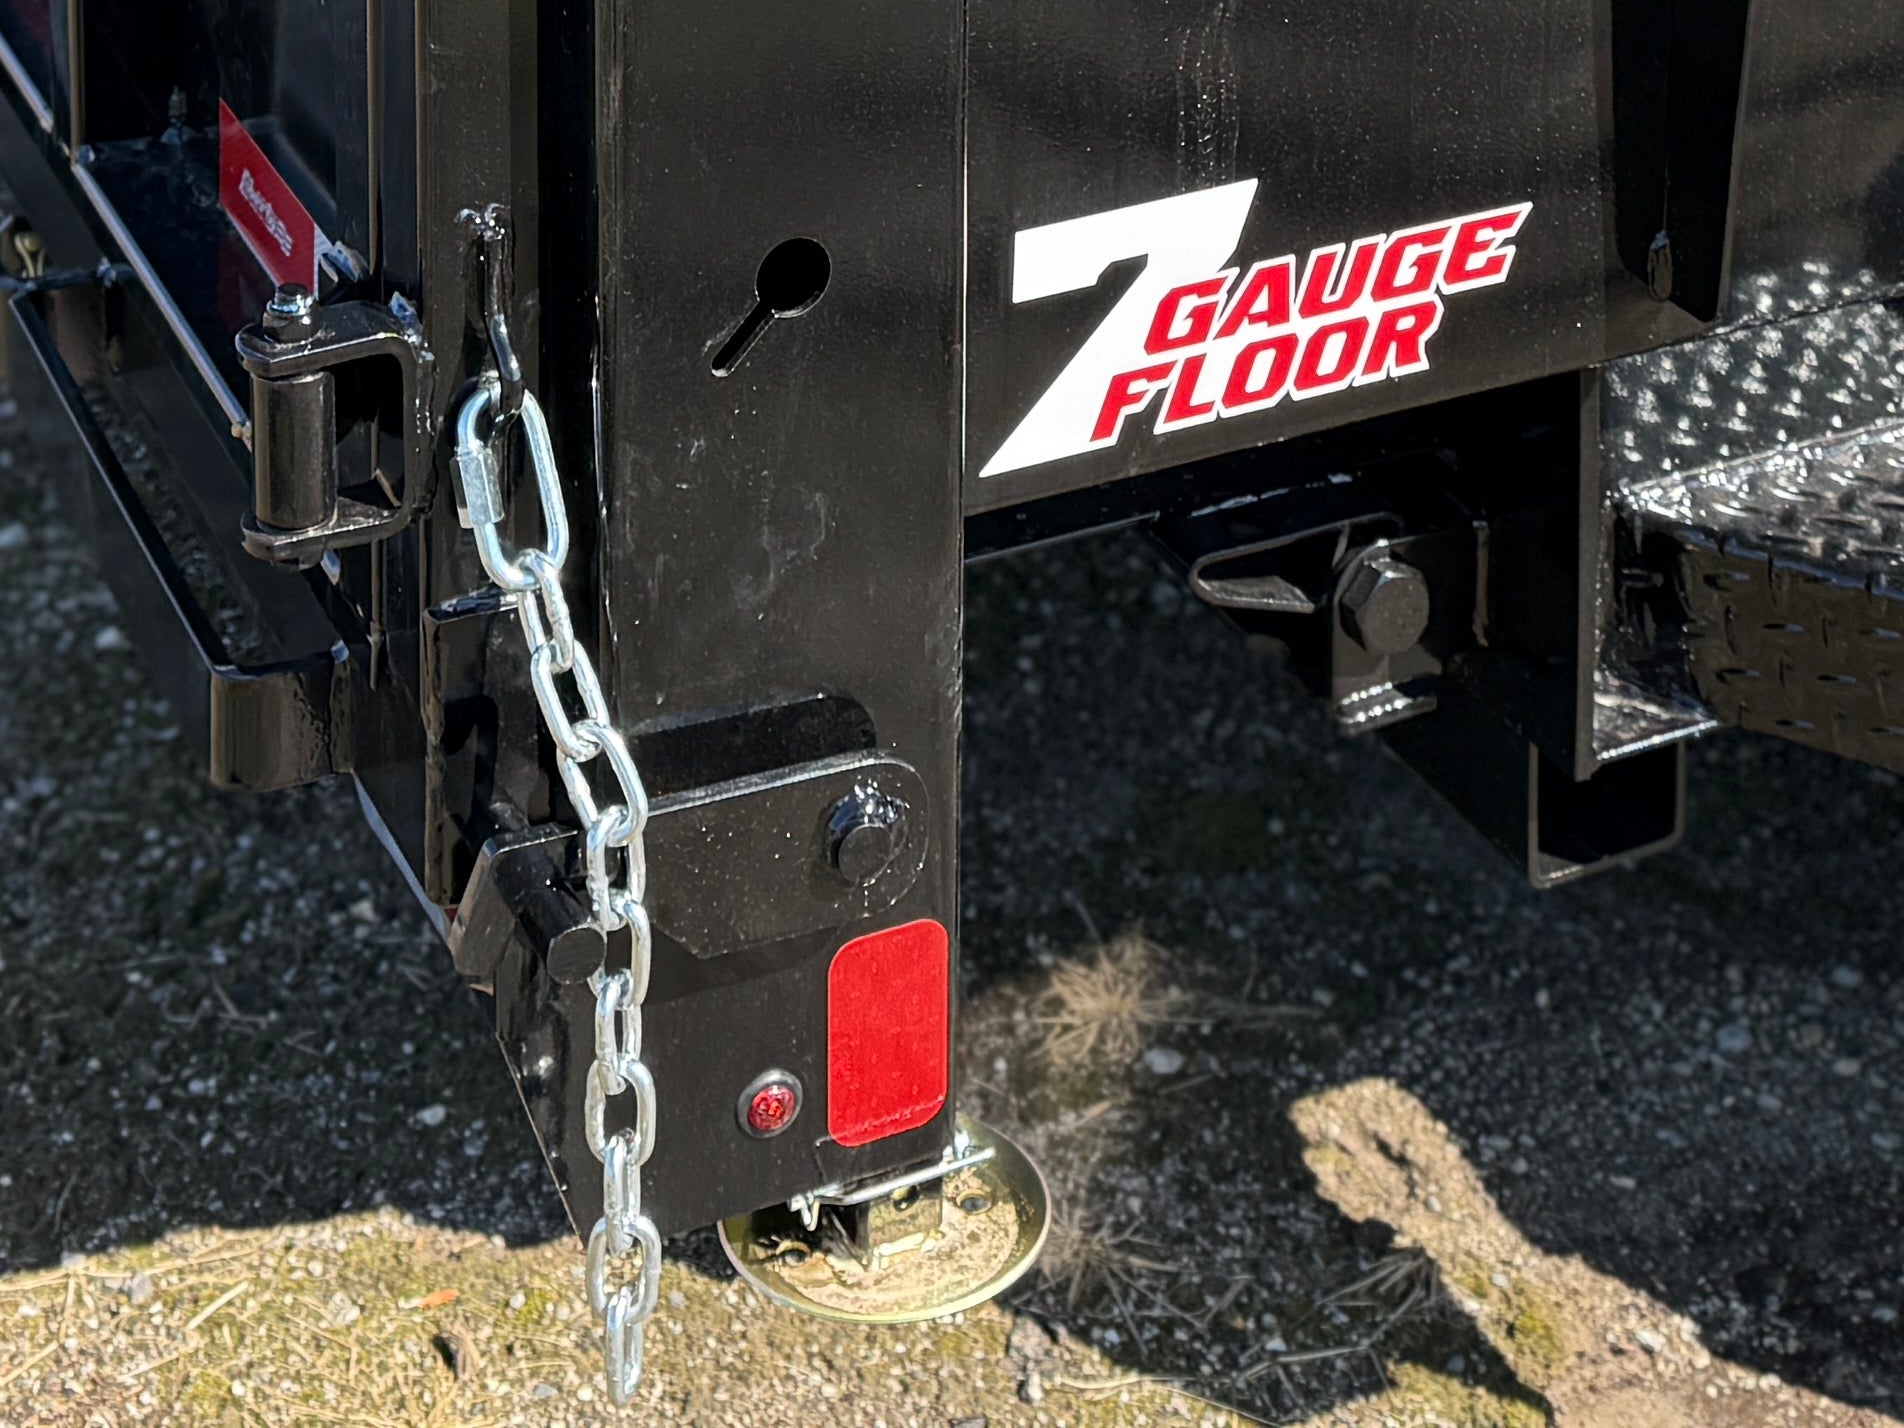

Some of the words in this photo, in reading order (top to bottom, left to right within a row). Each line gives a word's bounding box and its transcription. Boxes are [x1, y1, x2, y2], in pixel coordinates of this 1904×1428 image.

[979, 177, 1259, 478] 7
[1142, 200, 1533, 356] GAUGE
[1088, 294, 1444, 446] FLOOR
